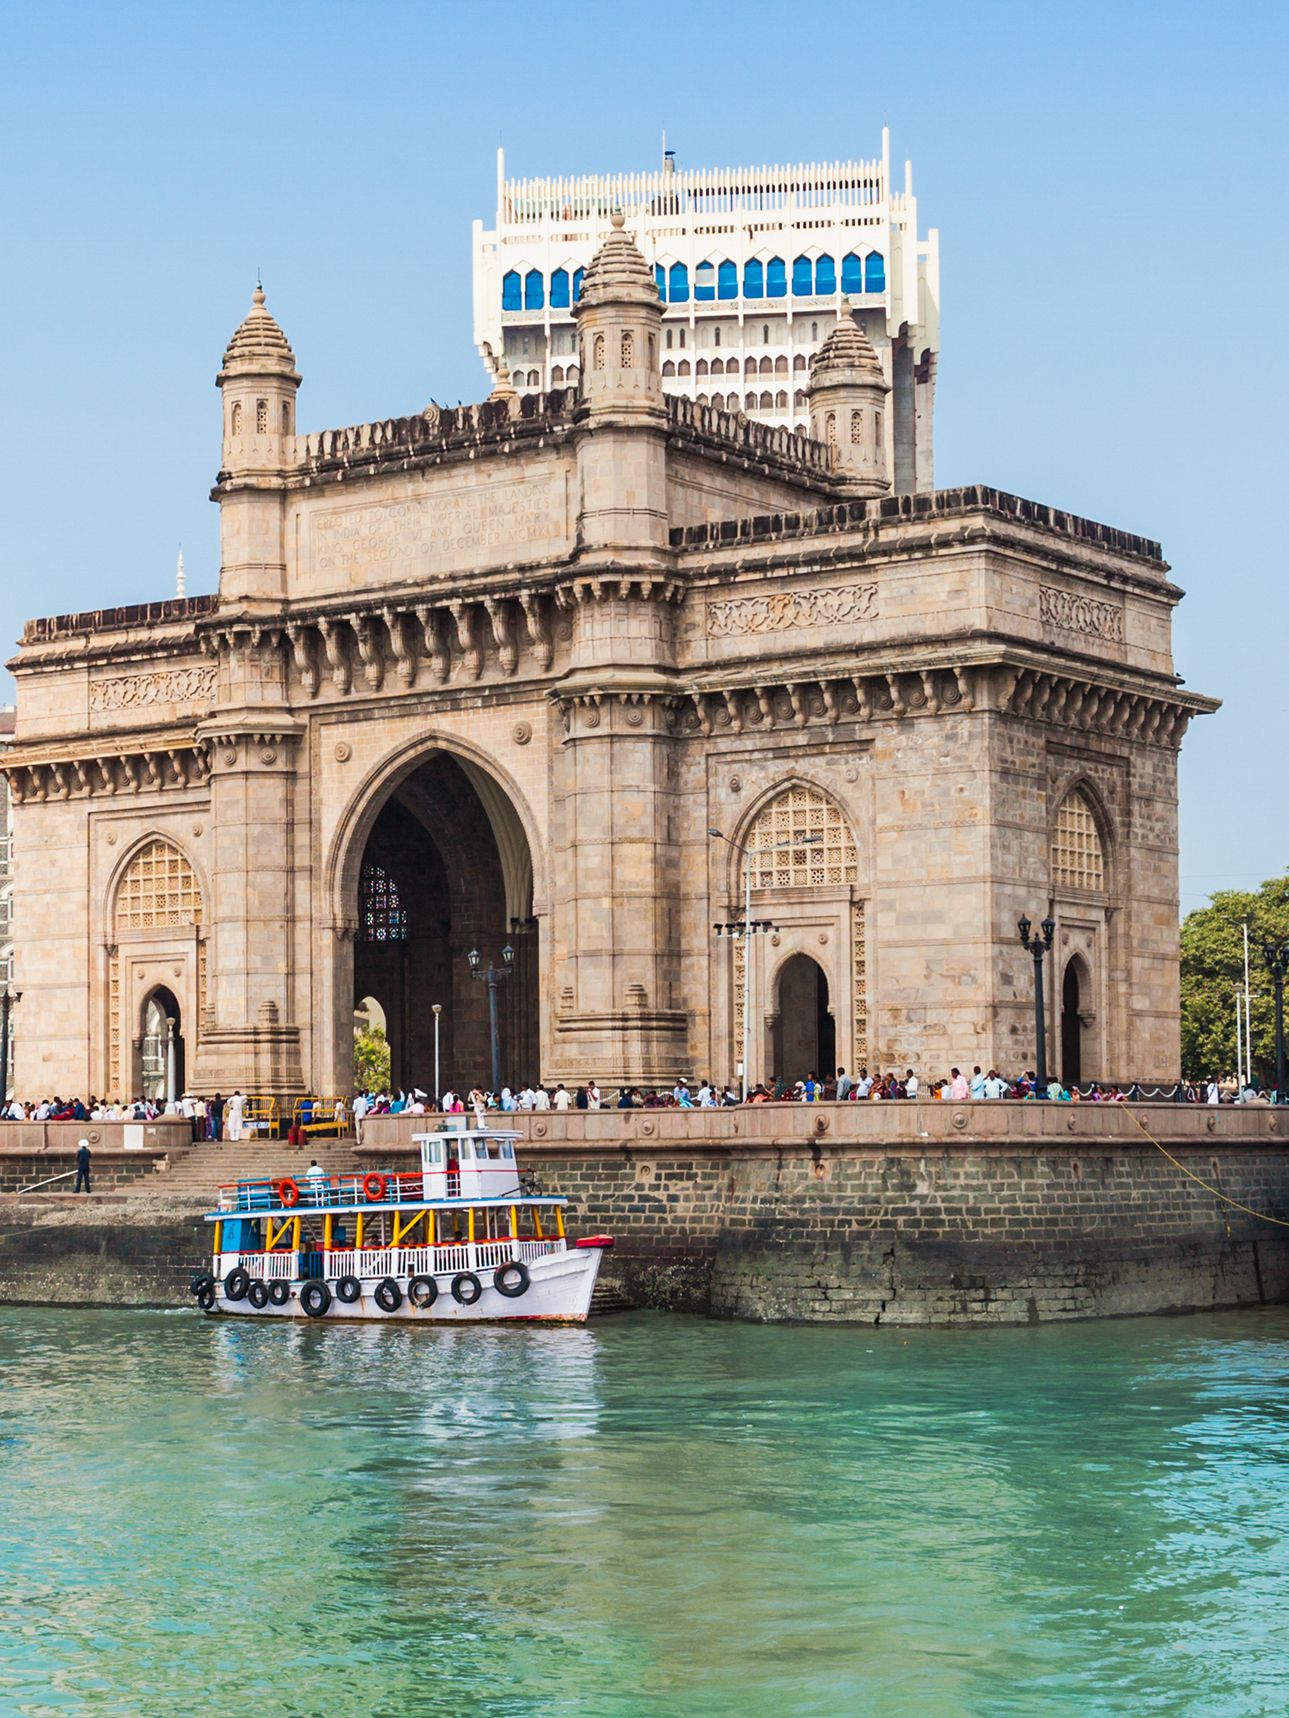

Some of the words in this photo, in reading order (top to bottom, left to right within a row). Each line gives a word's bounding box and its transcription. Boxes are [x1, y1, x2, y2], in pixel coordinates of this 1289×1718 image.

[317, 512, 362, 530] ERECTED
[369, 509, 382, 522] TO
[389, 495, 472, 518] COMMEMORATE
[478, 491, 497, 504] THE
[504, 482, 550, 501] LANDING
[317, 531, 327, 542] IN
[334, 527, 360, 540] INDIA
[369, 523, 382, 535] OF
[393, 517, 421, 531] THEIR
[431, 509, 478, 525] IMPERIAL
[489, 497, 550, 516] MAJESTIES
[317, 542, 341, 555] KING
[352, 533, 400, 551] GEORGE
[429, 526, 452, 539] AND
[463, 517, 504, 534] QUEEN
[514, 511, 550, 525] MARY
[319, 556, 335, 569] ON
[340, 552, 359, 565] THE
[367, 545, 413, 562] SECOND
[420, 541, 435, 554] OF
[443, 532, 500, 552] DECEMBER
[509, 525, 550, 541] MCMXI
